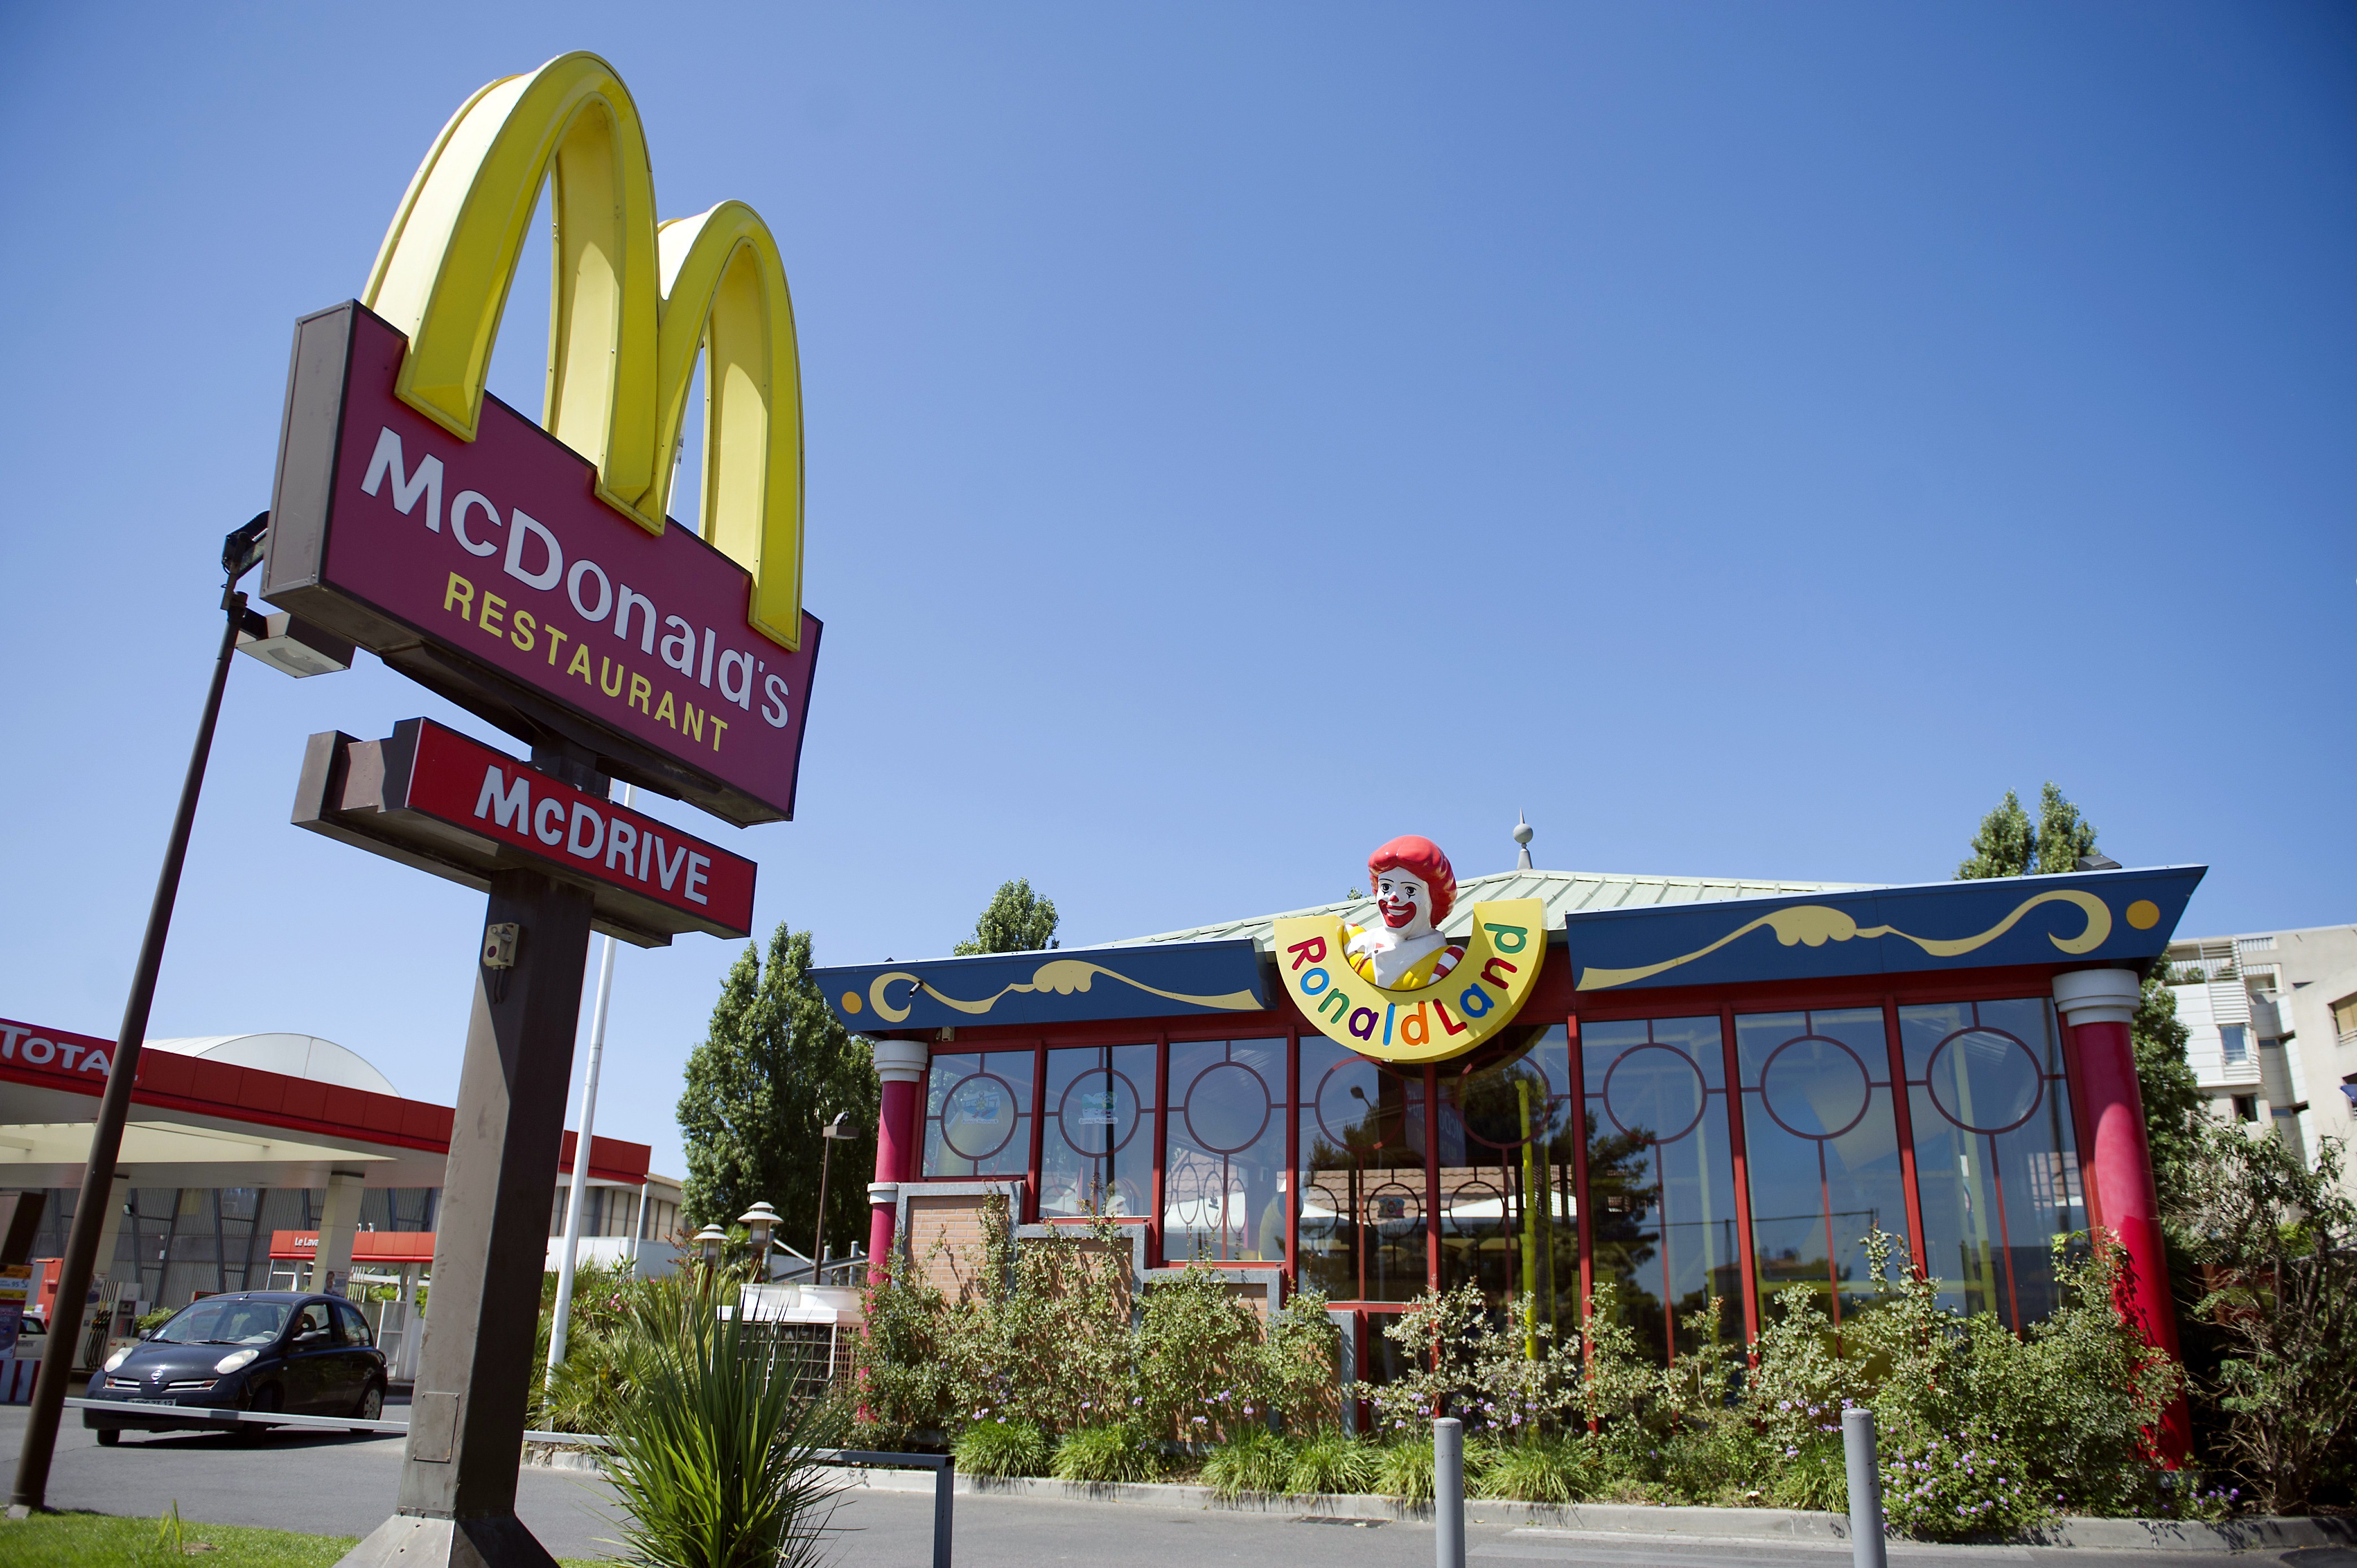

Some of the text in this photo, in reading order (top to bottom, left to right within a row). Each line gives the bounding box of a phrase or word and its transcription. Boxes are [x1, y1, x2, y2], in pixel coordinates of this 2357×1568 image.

[361, 426, 789, 728] McDonald's
[444, 571, 728, 752] RESTAURANT
[474, 764, 711, 905] McDRIVE
[0, 1023, 138, 1081] TOTA
[295, 1237, 303, 1247] Le
